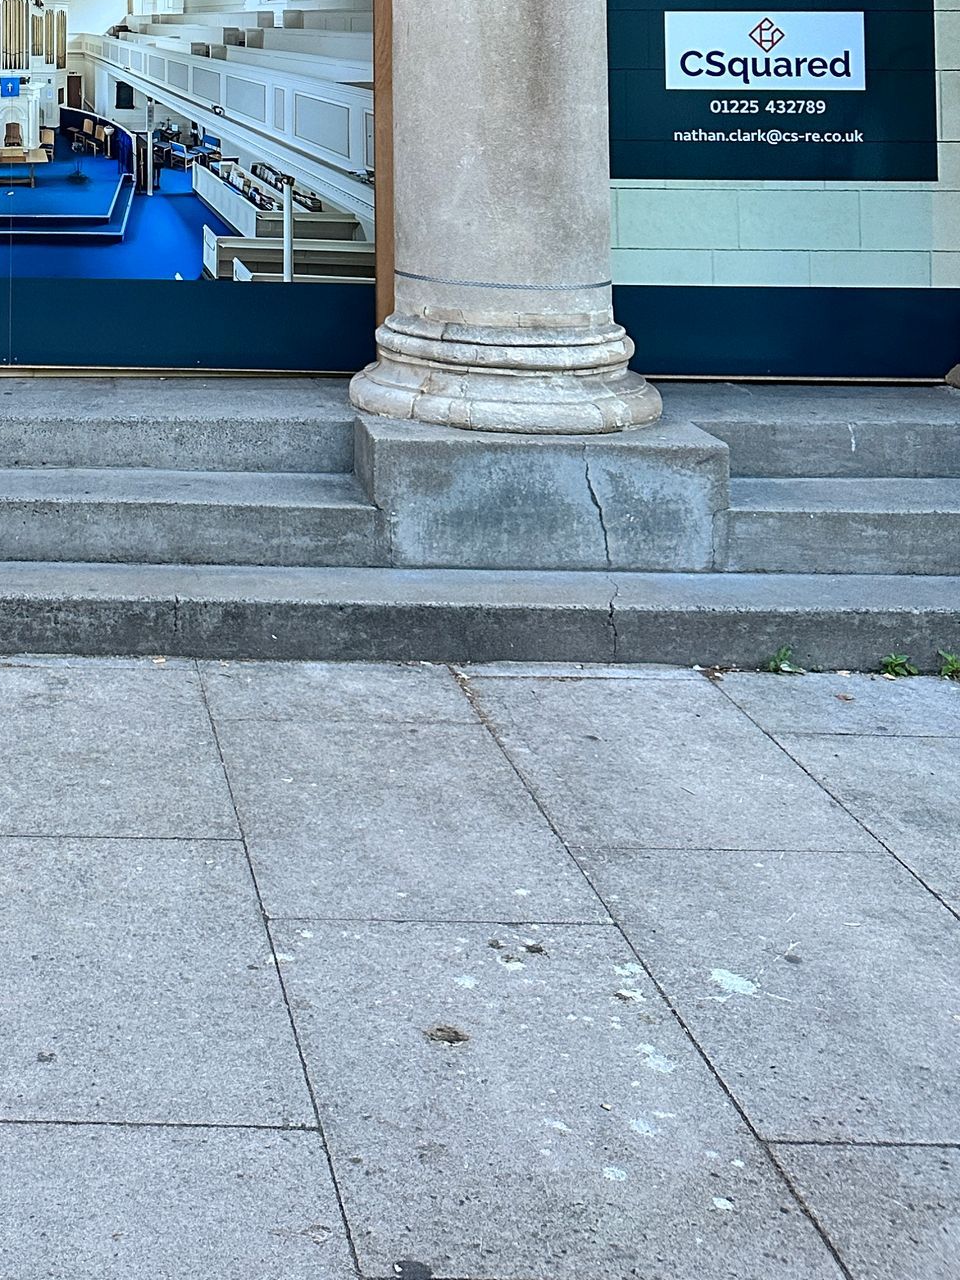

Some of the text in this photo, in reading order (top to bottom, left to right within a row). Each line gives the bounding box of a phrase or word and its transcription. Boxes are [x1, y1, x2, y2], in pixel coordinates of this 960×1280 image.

[679, 50, 852, 85] CSquared
[709, 99, 826, 114] 01225 432789
[673, 128, 864, 145] nathan.clark@cs-re.co.uk
